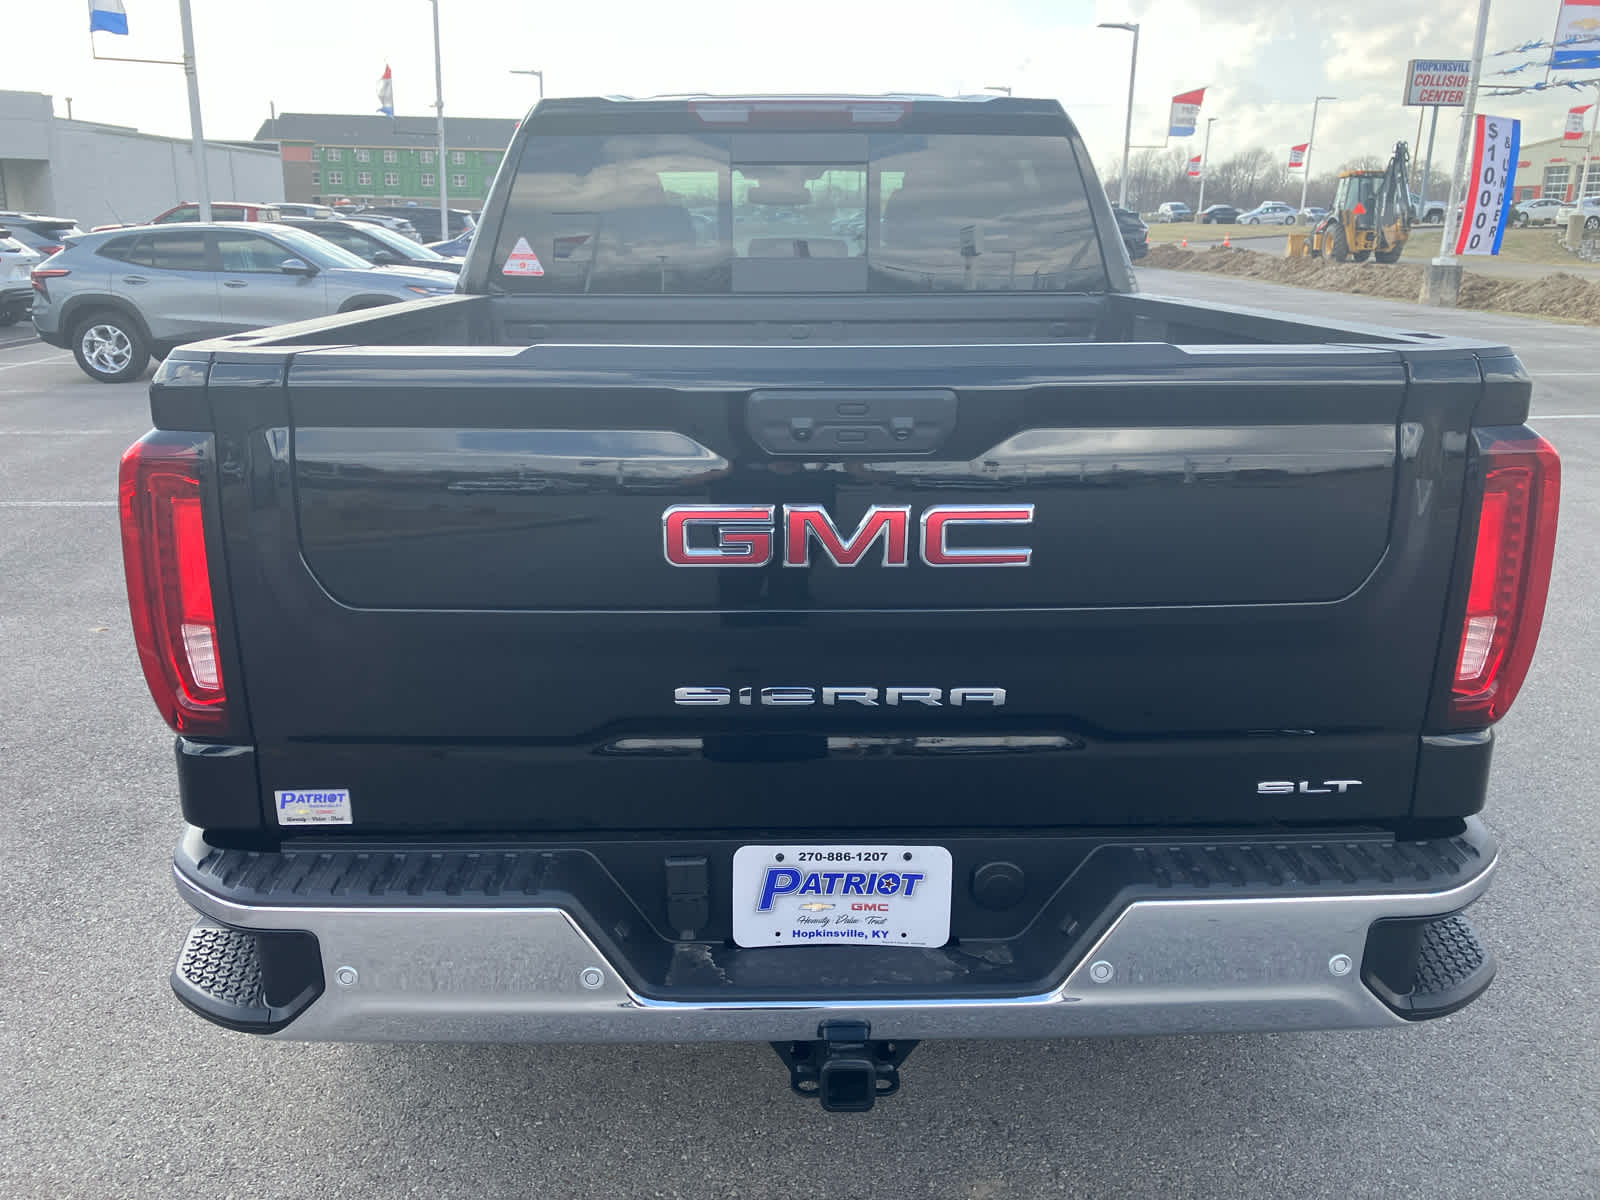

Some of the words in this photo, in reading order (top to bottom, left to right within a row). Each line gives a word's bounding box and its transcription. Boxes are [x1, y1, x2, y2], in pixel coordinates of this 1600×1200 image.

[1415, 62, 1470, 73] HOPKINSVILL
[1419, 89, 1464, 103] CENTER
[662, 503, 1035, 568] GMC
[674, 686, 1007, 707] SIERRA
[1257, 779, 1363, 794] SLT
[798, 852, 888, 862] 270-886-1207
[756, 866, 926, 913] PATRIOT
[851, 903, 889, 912] GMC
[792, 929, 868, 940] Hopkinsville,
[872, 929, 889, 939] KY
